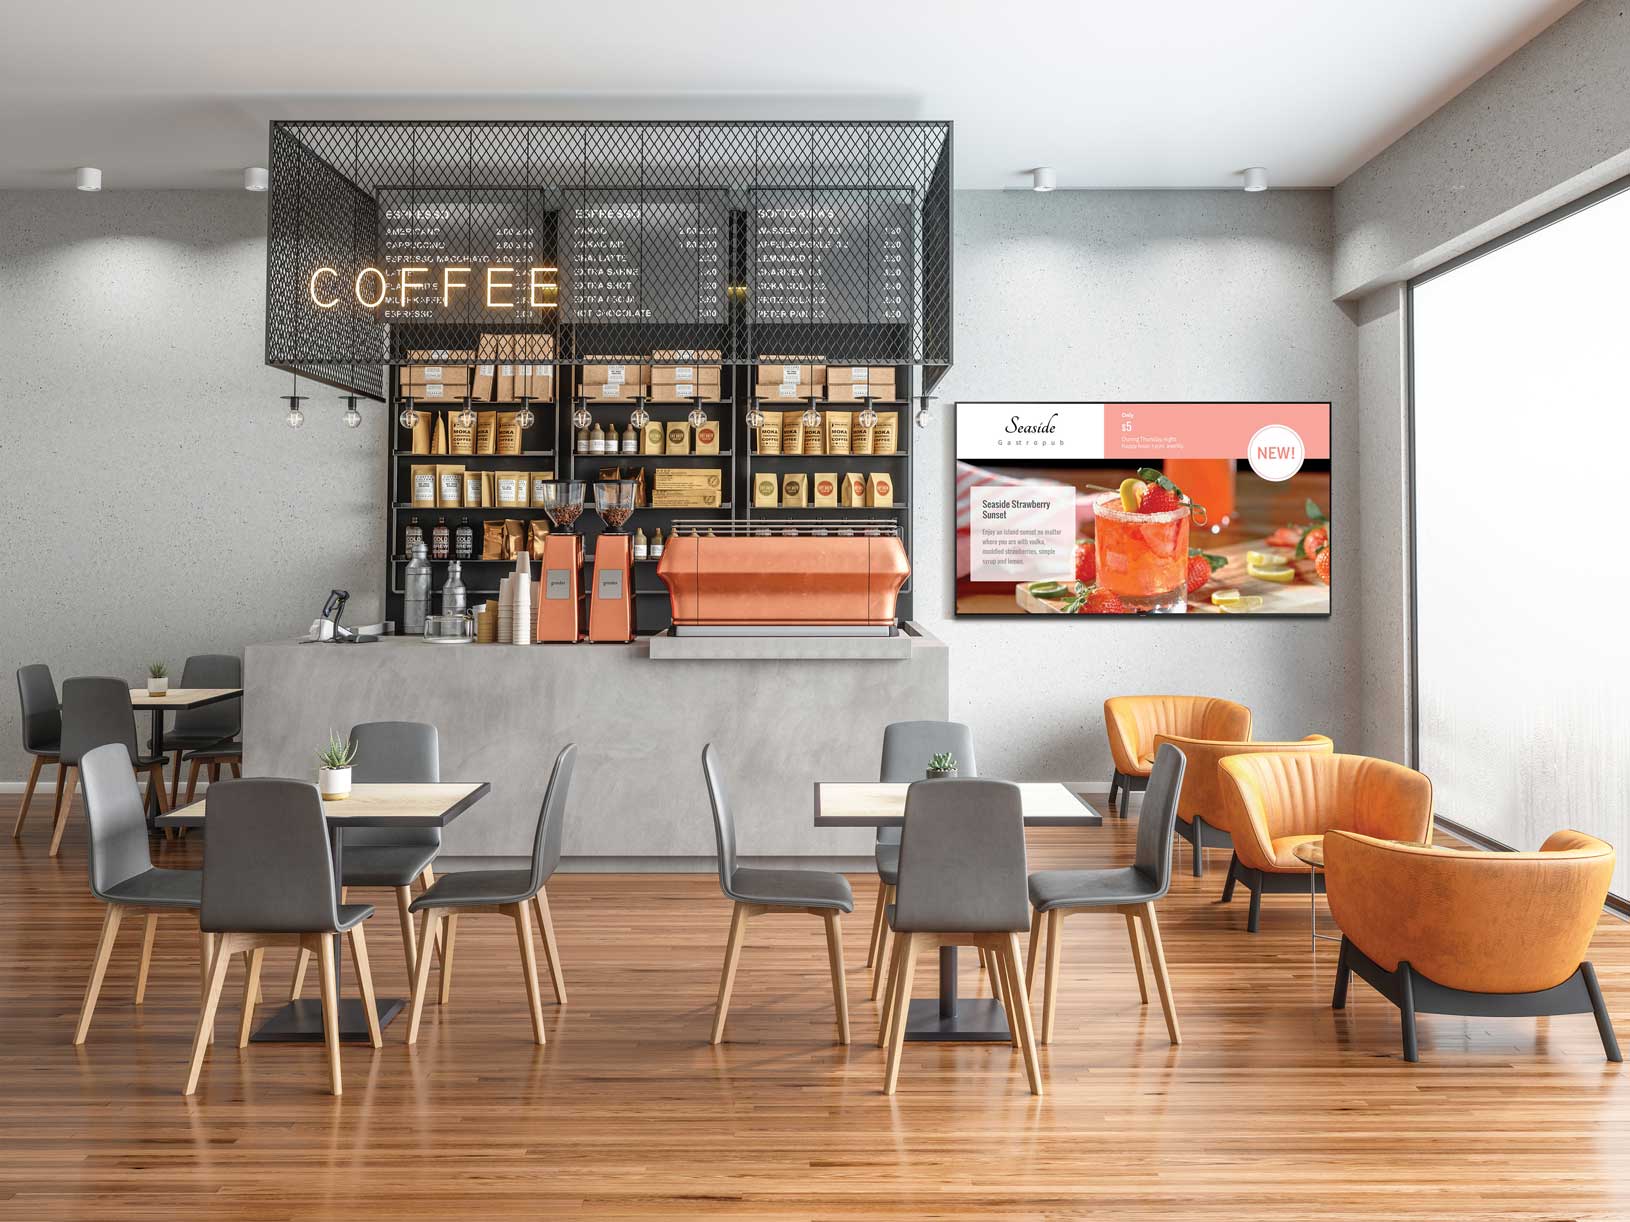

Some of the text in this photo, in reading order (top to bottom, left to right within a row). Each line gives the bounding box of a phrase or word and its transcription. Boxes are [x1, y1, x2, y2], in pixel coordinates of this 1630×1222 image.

[310, 267, 558, 308] COFFEE
[1005, 413, 1059, 434] Seaside
[1121, 421, 1132, 432] $5
[1257, 446, 1295, 460] NEW!
[982, 500, 1050, 510] Seaside Strawberry
[982, 510, 1007, 519] Sunset
[982, 528, 995, 536] Enjoy
